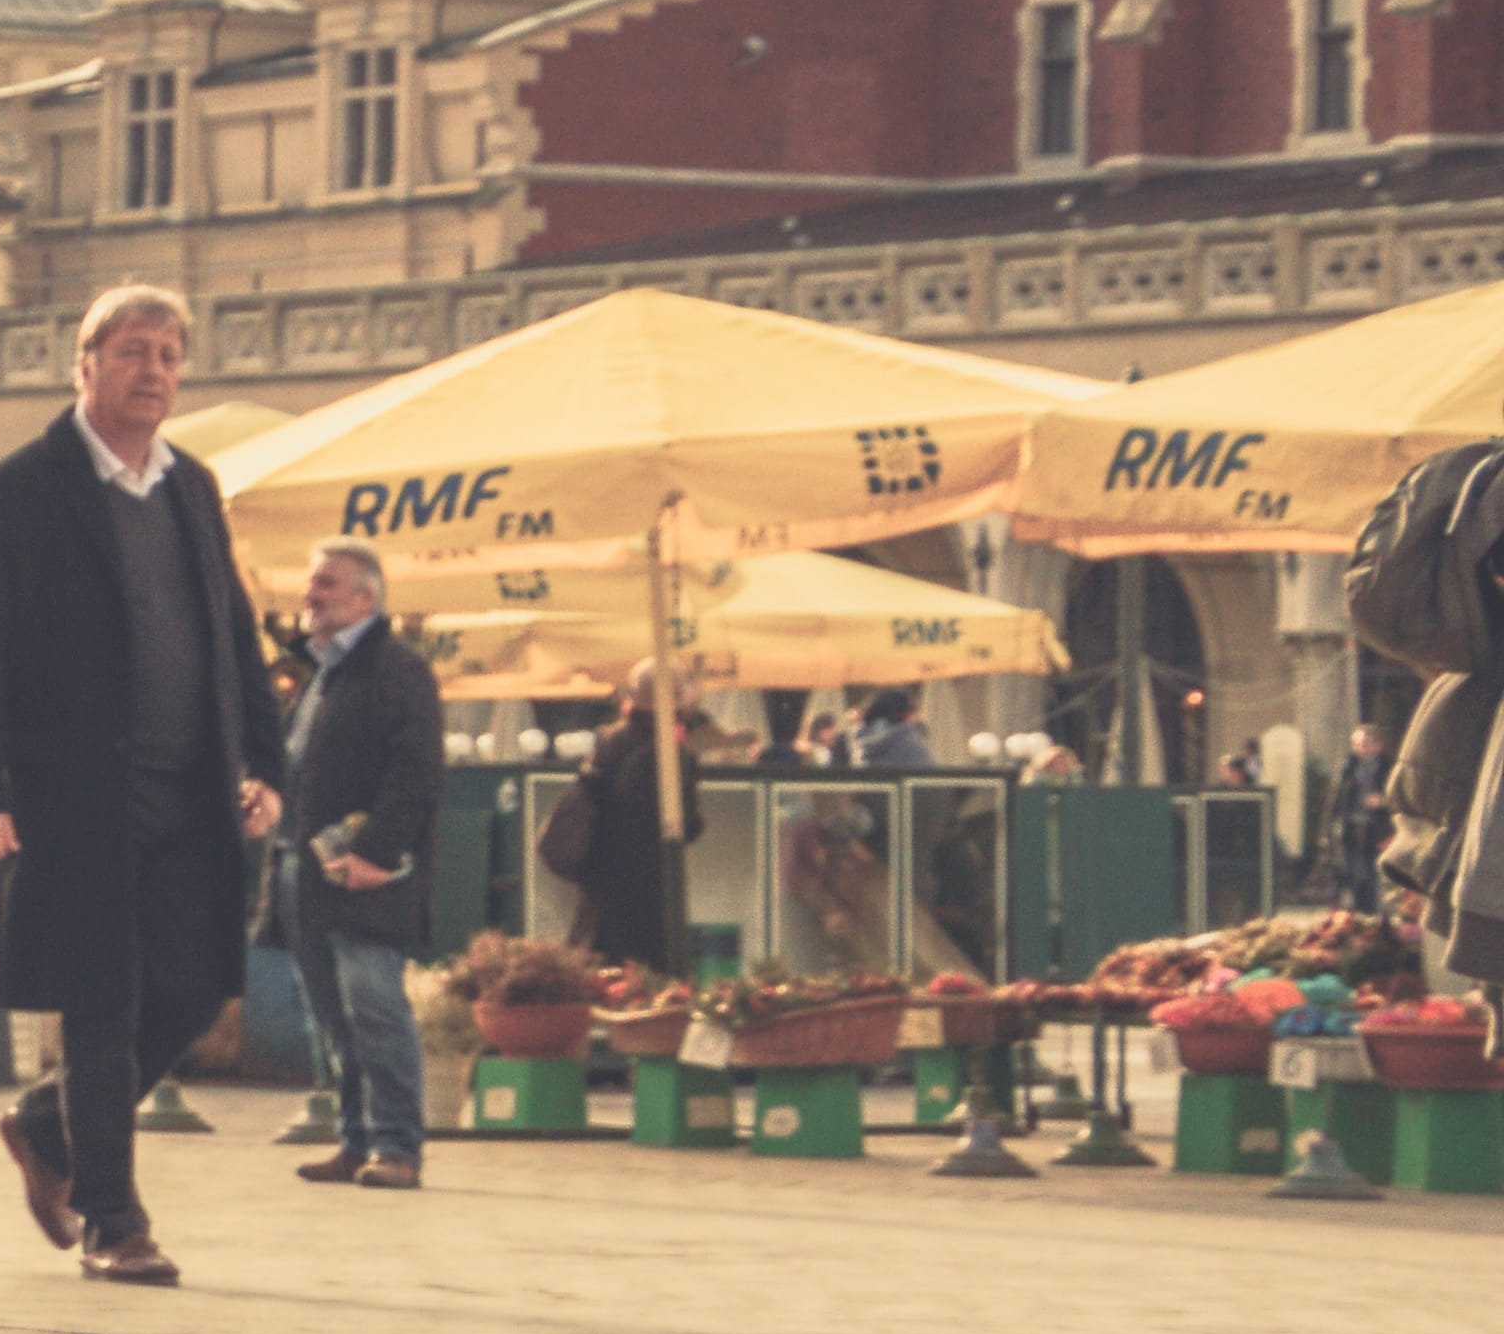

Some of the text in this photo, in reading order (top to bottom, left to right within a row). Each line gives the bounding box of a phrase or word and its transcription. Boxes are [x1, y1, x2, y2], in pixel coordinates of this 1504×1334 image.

[341, 465, 554, 538] RMF FM
[1104, 427, 1291, 519] RMF FM
